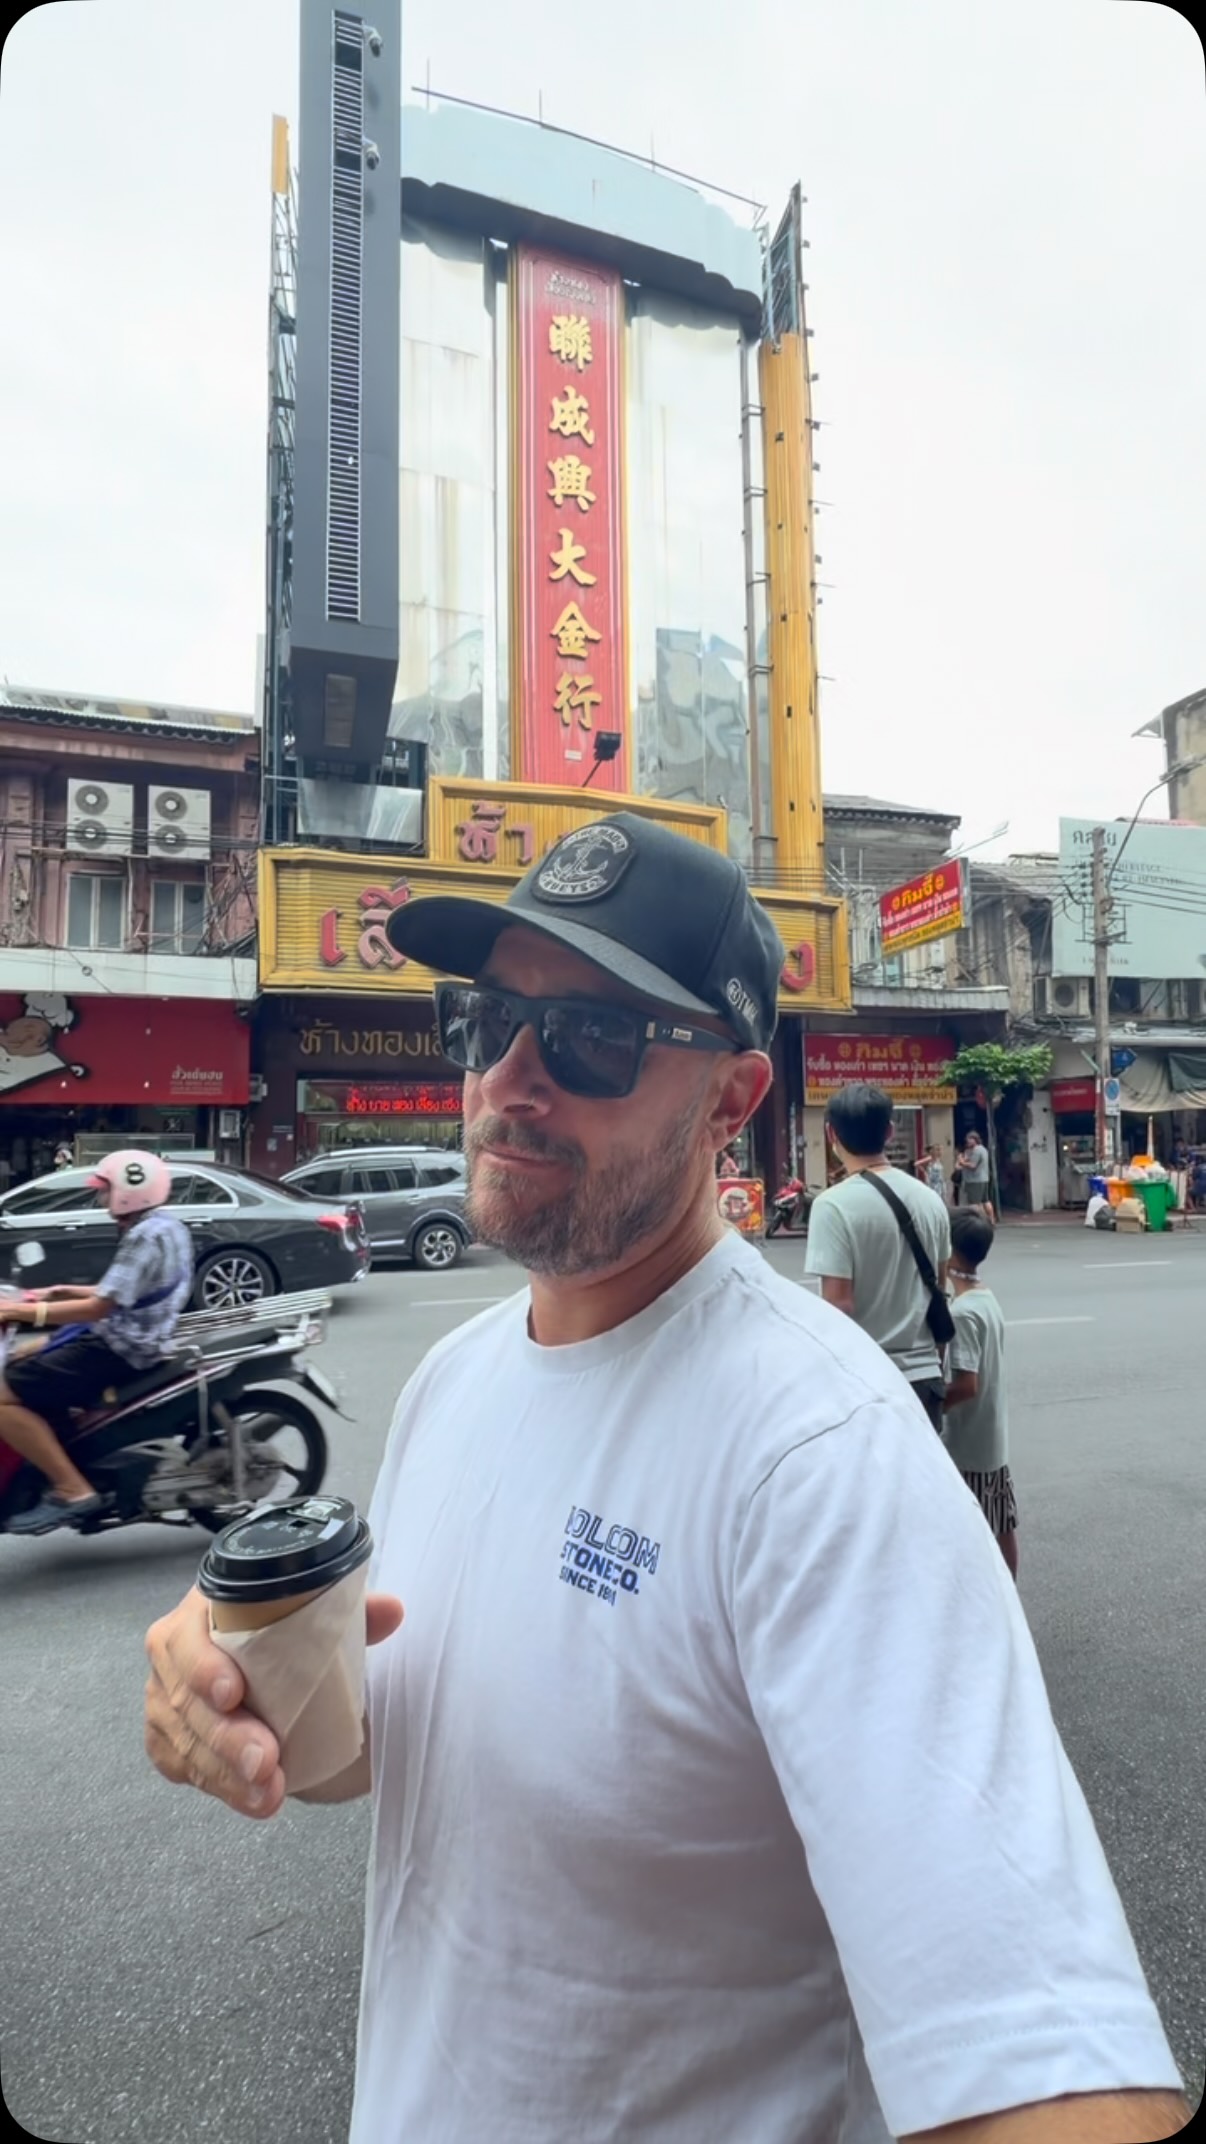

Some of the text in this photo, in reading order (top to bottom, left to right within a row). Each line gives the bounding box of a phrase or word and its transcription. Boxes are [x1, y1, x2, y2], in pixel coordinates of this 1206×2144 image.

[548, 314, 602, 730] 聯成興大金行
[455, 799, 569, 865] ห้า
[126, 1163, 145, 1186] 8
[564, 1505, 661, 1576] OLCOM
